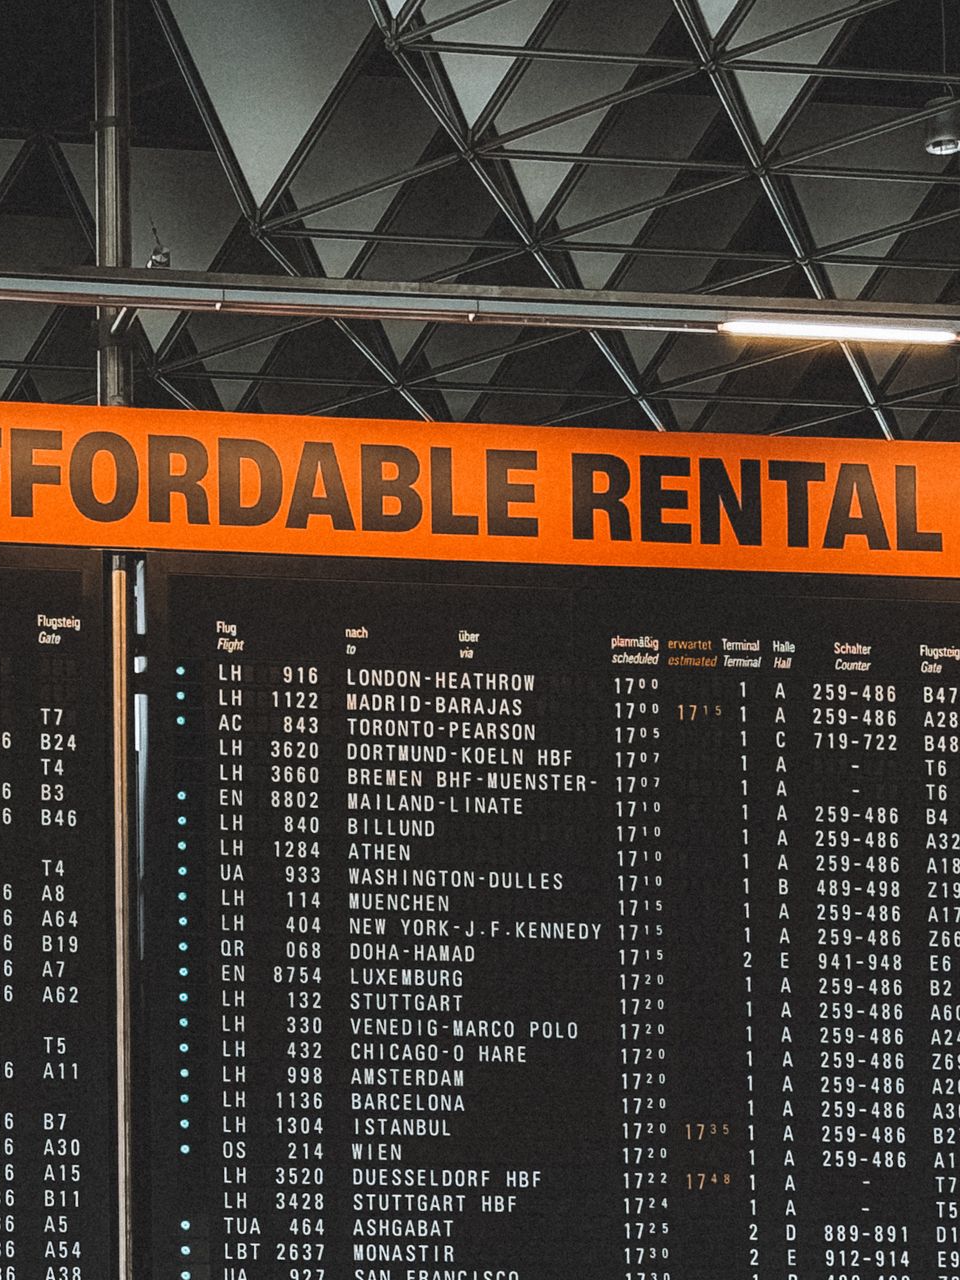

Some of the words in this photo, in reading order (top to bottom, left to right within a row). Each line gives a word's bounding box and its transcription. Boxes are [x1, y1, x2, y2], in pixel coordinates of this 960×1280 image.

[572, 454, 942, 551] RENTAL
[38, 614, 80, 631] Flugsteig
[38, 631, 61, 644] Gate
[216, 621, 236, 636] Flug
[345, 626, 368, 638] nach
[459, 630, 480, 642] über
[611, 635, 659, 651] planmäßig
[668, 640, 711, 650] erwartet
[722, 638, 759, 651] Terminal
[773, 641, 795, 653] Halle
[834, 642, 871, 655] Schalter
[920, 645, 960, 660] Flugsteig
[217, 638, 244, 653] Flight
[346, 644, 356, 654] to
[460, 647, 473, 658] via
[612, 652, 659, 665] scheduled
[668, 656, 717, 667] estimated
[724, 655, 761, 667] Terminal
[774, 657, 792, 668] Hall
[835, 659, 871, 671] Counter
[921, 661, 942, 673] Gate
[348, 669, 534, 691] LONDON-HEATHROW
[272, 691, 317, 708] 1122
[347, 694, 521, 716] MADRID-BARAJAS
[41, 708, 62, 725] T7
[219, 714, 241, 731] AC
[347, 718, 535, 740] TORONTO-PEARSON
[814, 733, 896, 750] 719-722
[41, 734, 76, 751] B24
[348, 743, 523, 765] DORTMUND-KOELN
[538, 749, 571, 766] HBF
[348, 768, 421, 786] BREMEN
[437, 771, 596, 791] BHF-MUENSTER-
[272, 791, 318, 808] 8802
[348, 793, 522, 814] MAILAND-LINATE
[348, 818, 434, 836] BILLUND
[349, 843, 410, 860] ATHEN
[221, 864, 243, 880] UA
[349, 868, 562, 889] WASHINGTON-DULLES
[817, 880, 899, 897] 489-498
[350, 893, 448, 911] MUENCHEN
[42, 910, 77, 927] A64
[350, 918, 385, 934] NEW
[401, 919, 601, 939] YORK-J.F.KENNEDY
[351, 943, 474, 962] DOHA-HAMAD
[819, 953, 901, 970] 941-948
[274, 966, 321, 983] 8754
[351, 968, 462, 987] LUXEMBURG
[43, 986, 78, 1003] A62
[351, 993, 462, 1011] STUTTGART
[351, 1018, 514, 1037] VENEDIG-MARCO
[530, 1022, 577, 1039] POLO
[351, 1043, 463, 1061] CHICAGO-O
[479, 1046, 526, 1062] HARE
[43, 1063, 77, 1079] A11
[351, 1068, 463, 1086] AMSTERDAM
[352, 1093, 464, 1111] BARCELONA
[355, 1118, 450, 1136] ISTANBUL
[352, 1144, 401, 1160] WIEN
[44, 1164, 80, 1181] A15
[276, 1167, 323, 1184] 3520
[353, 1169, 489, 1186] DUESSELDORF
[507, 1171, 540, 1187] HBF
[353, 1194, 465, 1211] STUTTGART
[482, 1196, 516, 1212] HBF
[353, 1219, 453, 1237] ASHGABAT
[825, 1225, 907, 1242] 889-891
[354, 1244, 453, 1262] MONASTIR
[826, 1250, 909, 1267] 912-914
